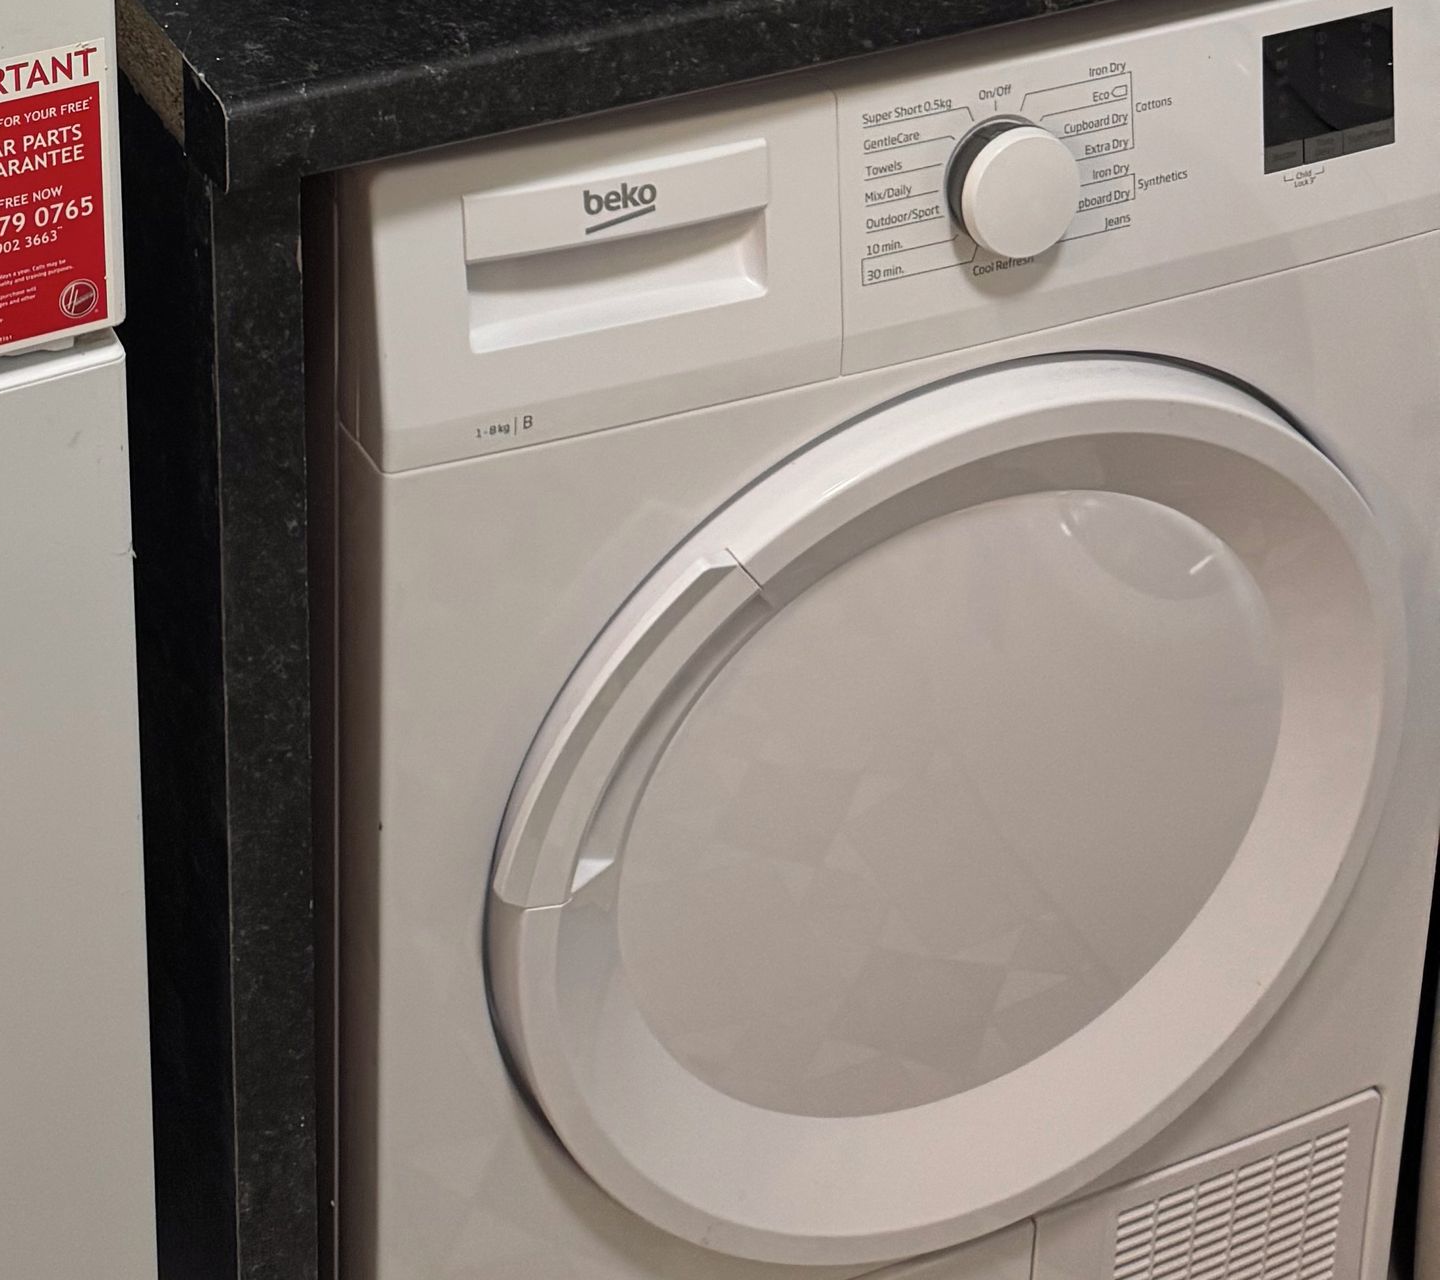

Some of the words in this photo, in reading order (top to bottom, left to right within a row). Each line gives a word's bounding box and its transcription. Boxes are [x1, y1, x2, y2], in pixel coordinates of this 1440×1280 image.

[1089, 65, 1108, 77] Iron
[1110, 62, 1126, 74] Dry
[979, 84, 1011, 100] On/Off
[1092, 91, 1110, 102] Eco
[862, 110, 892, 125] Super
[894, 104, 922, 118] Short
[924, 99, 952, 111] 0.5kg
[1135, 97, 1173, 113] Cottons
[23, 106, 57, 123] YOUR
[1063, 114, 1110, 134] Cupboard
[1111, 113, 1128, 125] Dry
[23, 123, 83, 152] PARTS
[863, 131, 920, 150] GentleCare
[1085, 142, 1110, 155] Extra
[1112, 138, 1129, 150] Dry
[866, 161, 903, 176] Towels
[1092, 168, 1111, 180] Iron
[1113, 164, 1130, 175] Dry
[1137, 170, 1188, 191] Synthetics
[32, 185, 63, 202] NOW
[583, 182, 657, 216] beko
[865, 184, 912, 203] Mix/Daily
[1078, 192, 1112, 209] pboard
[1114, 189, 1130, 201] Dry
[34, 195, 94, 228] 0765
[866, 205, 939, 230] Outdoor/Sport
[1104, 214, 1131, 230] Jeans
[866, 243, 880, 256] 10
[881, 240, 903, 252] min.
[867, 268, 881, 281] 30
[883, 265, 904, 278] min.
[972, 262, 994, 276] Cool
[523, 415, 533, 430] B
